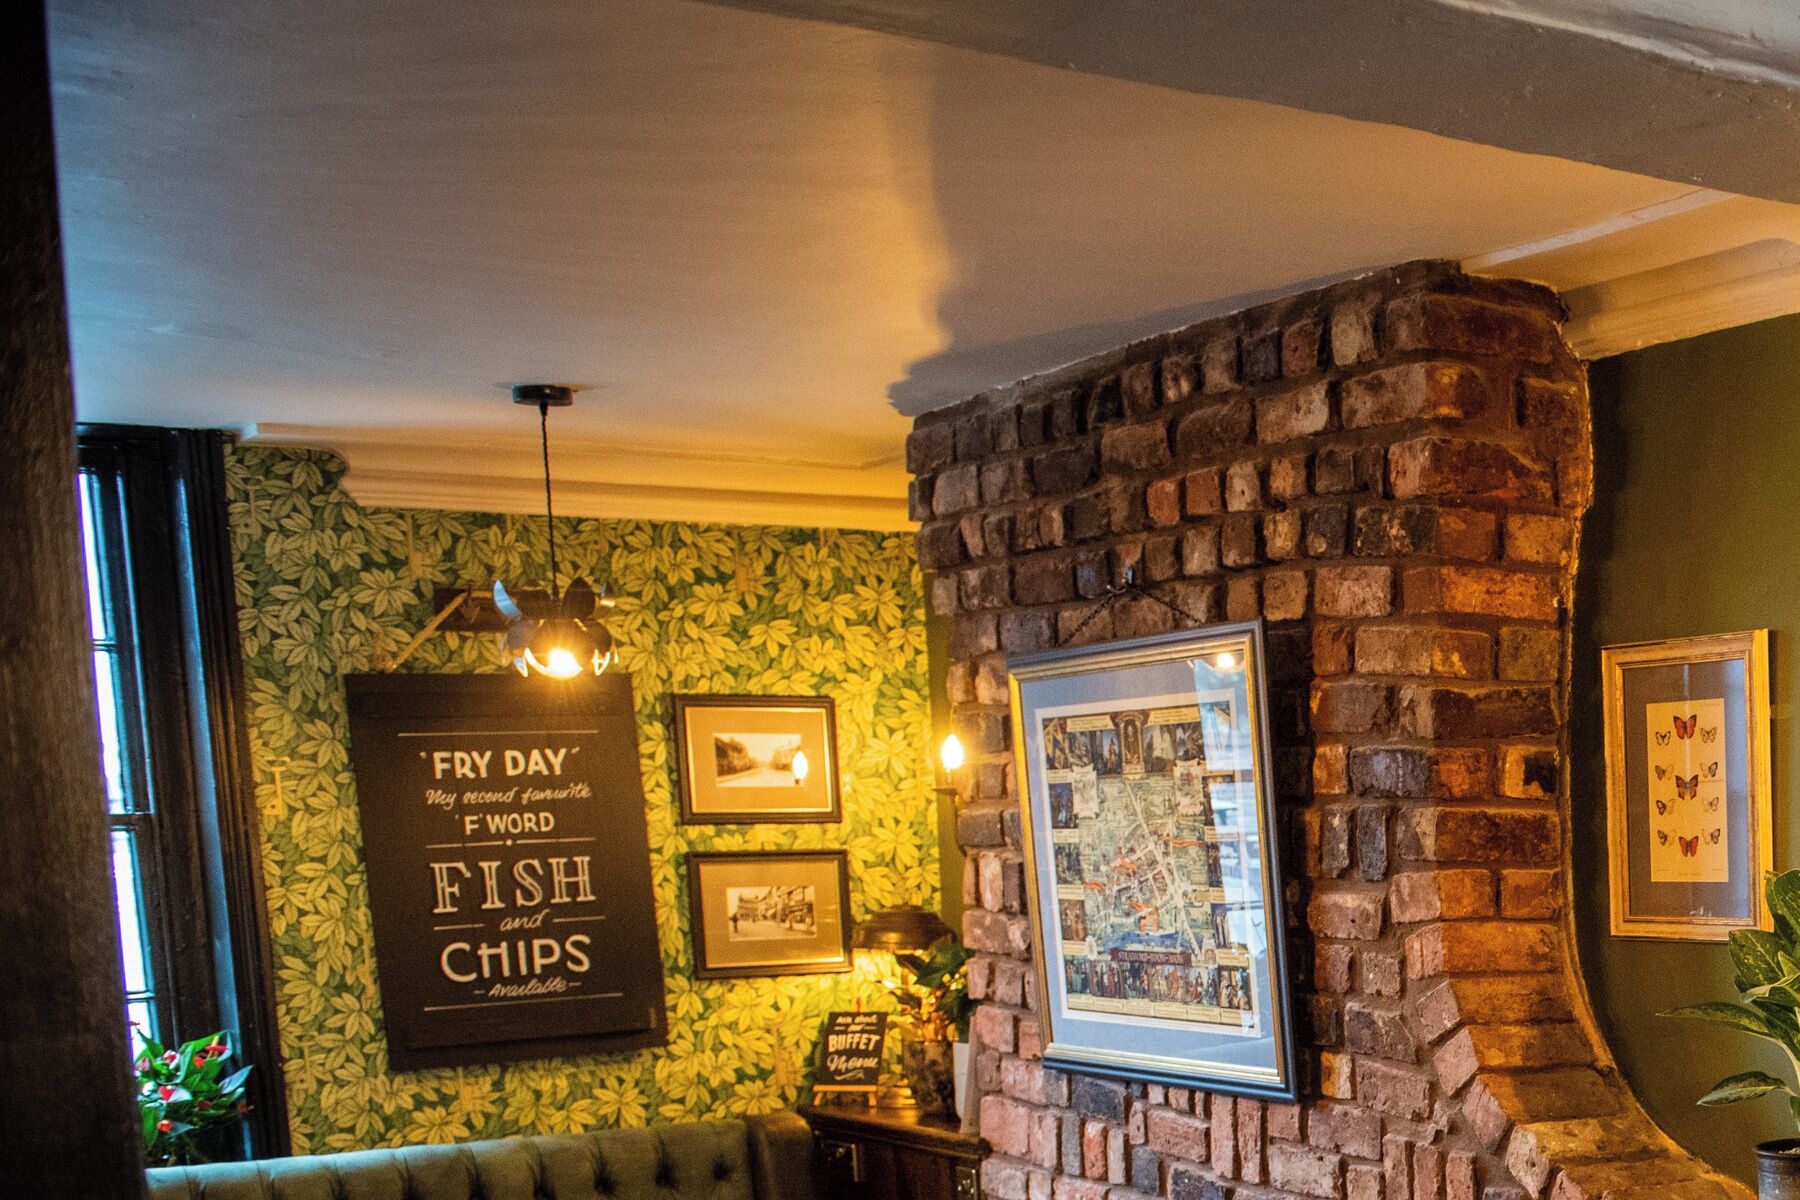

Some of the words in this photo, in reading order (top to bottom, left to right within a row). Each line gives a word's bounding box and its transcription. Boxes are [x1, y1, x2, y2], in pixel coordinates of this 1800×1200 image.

[425, 789, 457, 811] My
[463, 786, 519, 804] second
[486, 812, 555, 834] WORD
[430, 855, 597, 914] FISH
[500, 908, 550, 931] and
[441, 934, 591, 983] CHIPS
[828, 1032, 881, 1053] BUFFET
[827, 1054, 879, 1073] Menu
